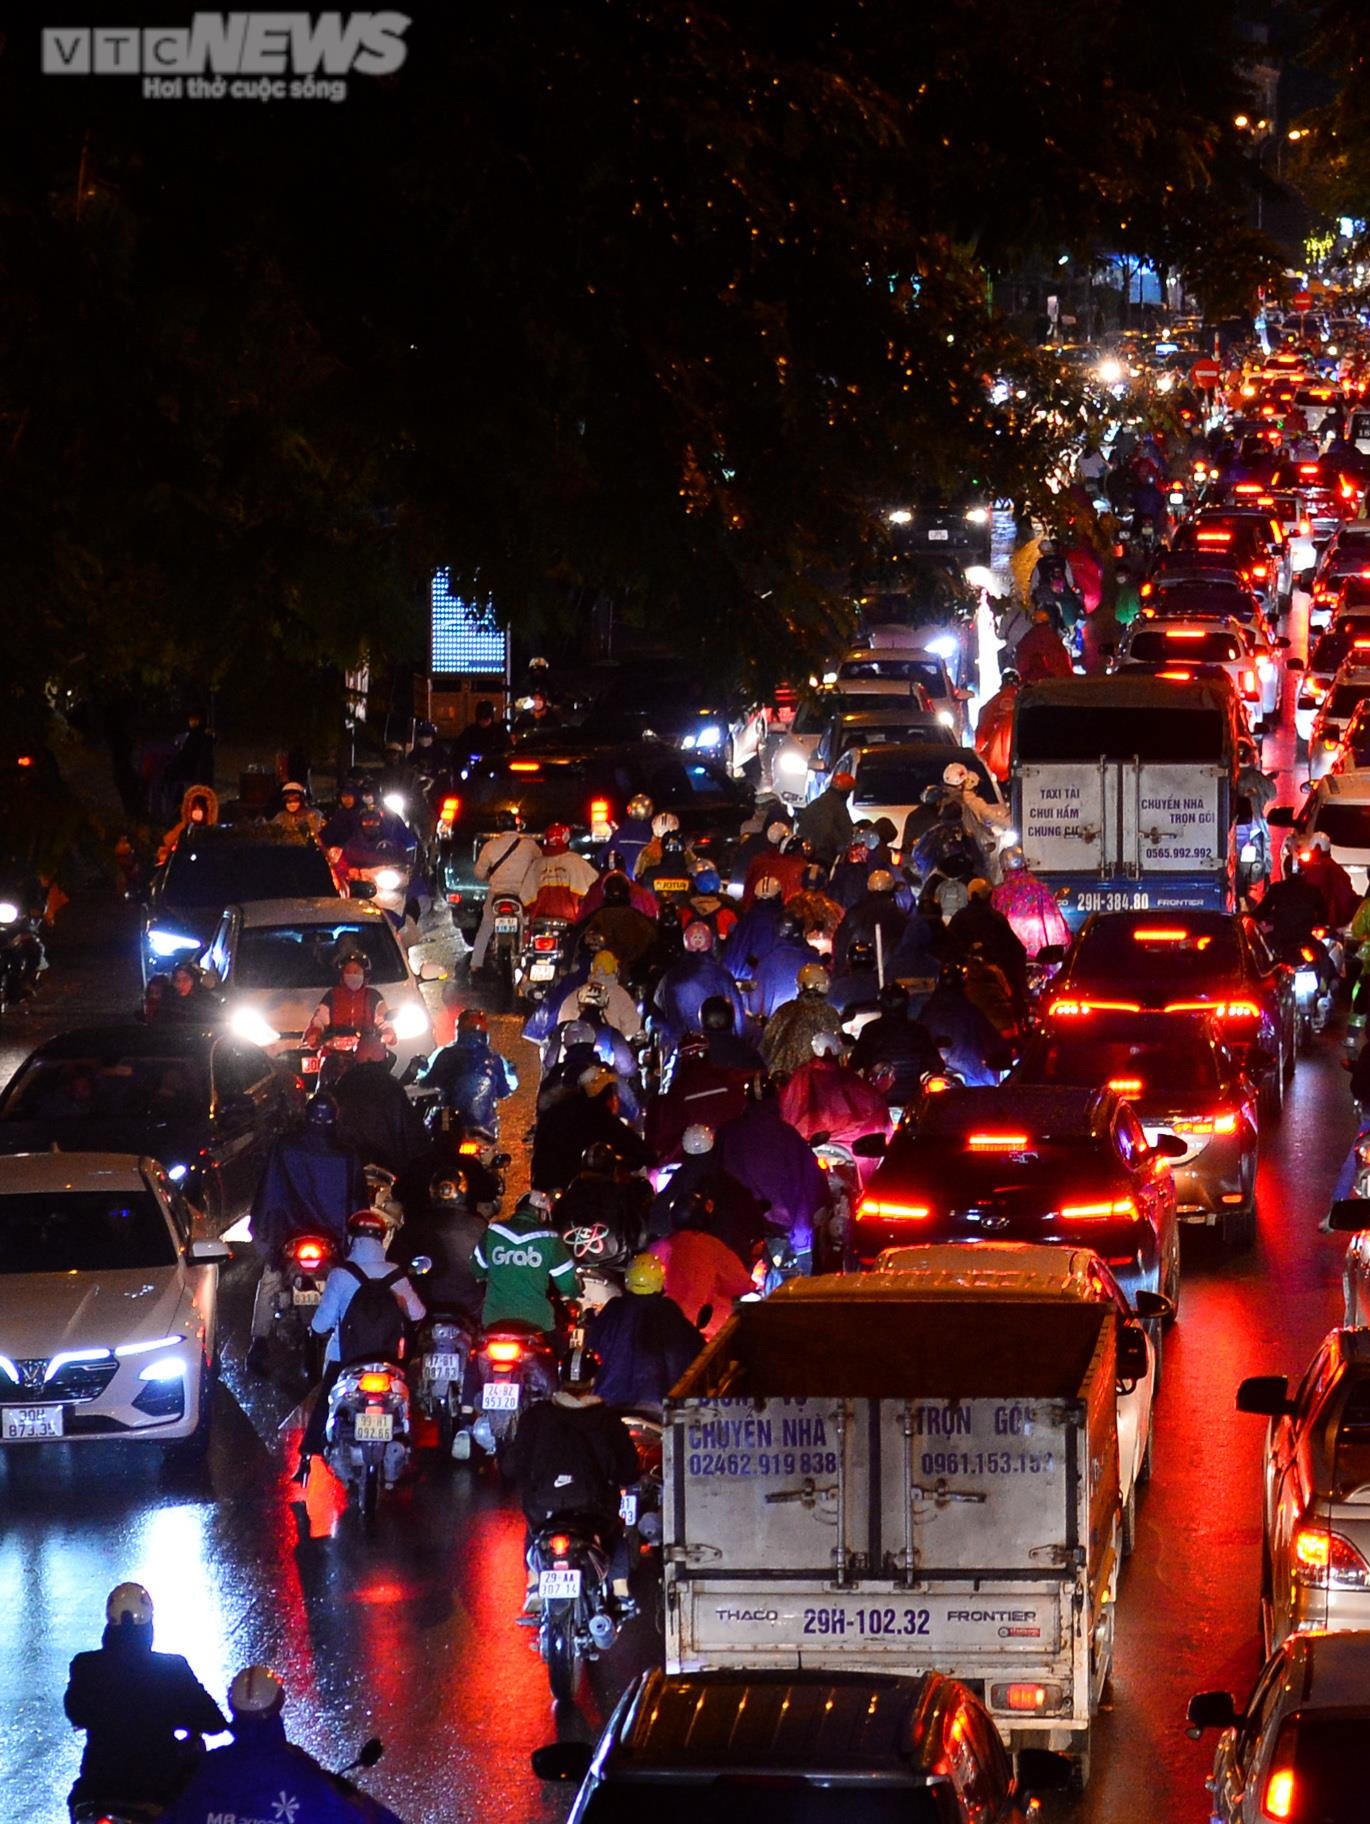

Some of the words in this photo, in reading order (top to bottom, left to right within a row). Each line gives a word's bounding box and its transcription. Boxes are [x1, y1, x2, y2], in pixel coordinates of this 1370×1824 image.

[1041, 788, 1062, 799] TAXI
[1029, 807, 1054, 818] CHUI
[1028, 826, 1062, 837] CHUNG
[1146, 847, 1213, 859] 0565.992.992
[1077, 893, 1149, 911] 29H-384.80
[1156, 899, 1205, 907] FRONTIER
[491, 1246, 543, 1268] Grab
[915, 1405, 972, 1440] TRỌN
[782, 1414, 827, 1447] NHÀ
[715, 1610, 779, 1621] THACO
[803, 1608, 931, 1635] 29H-102.32
[947, 1610, 1037, 1622] FRONTIER
